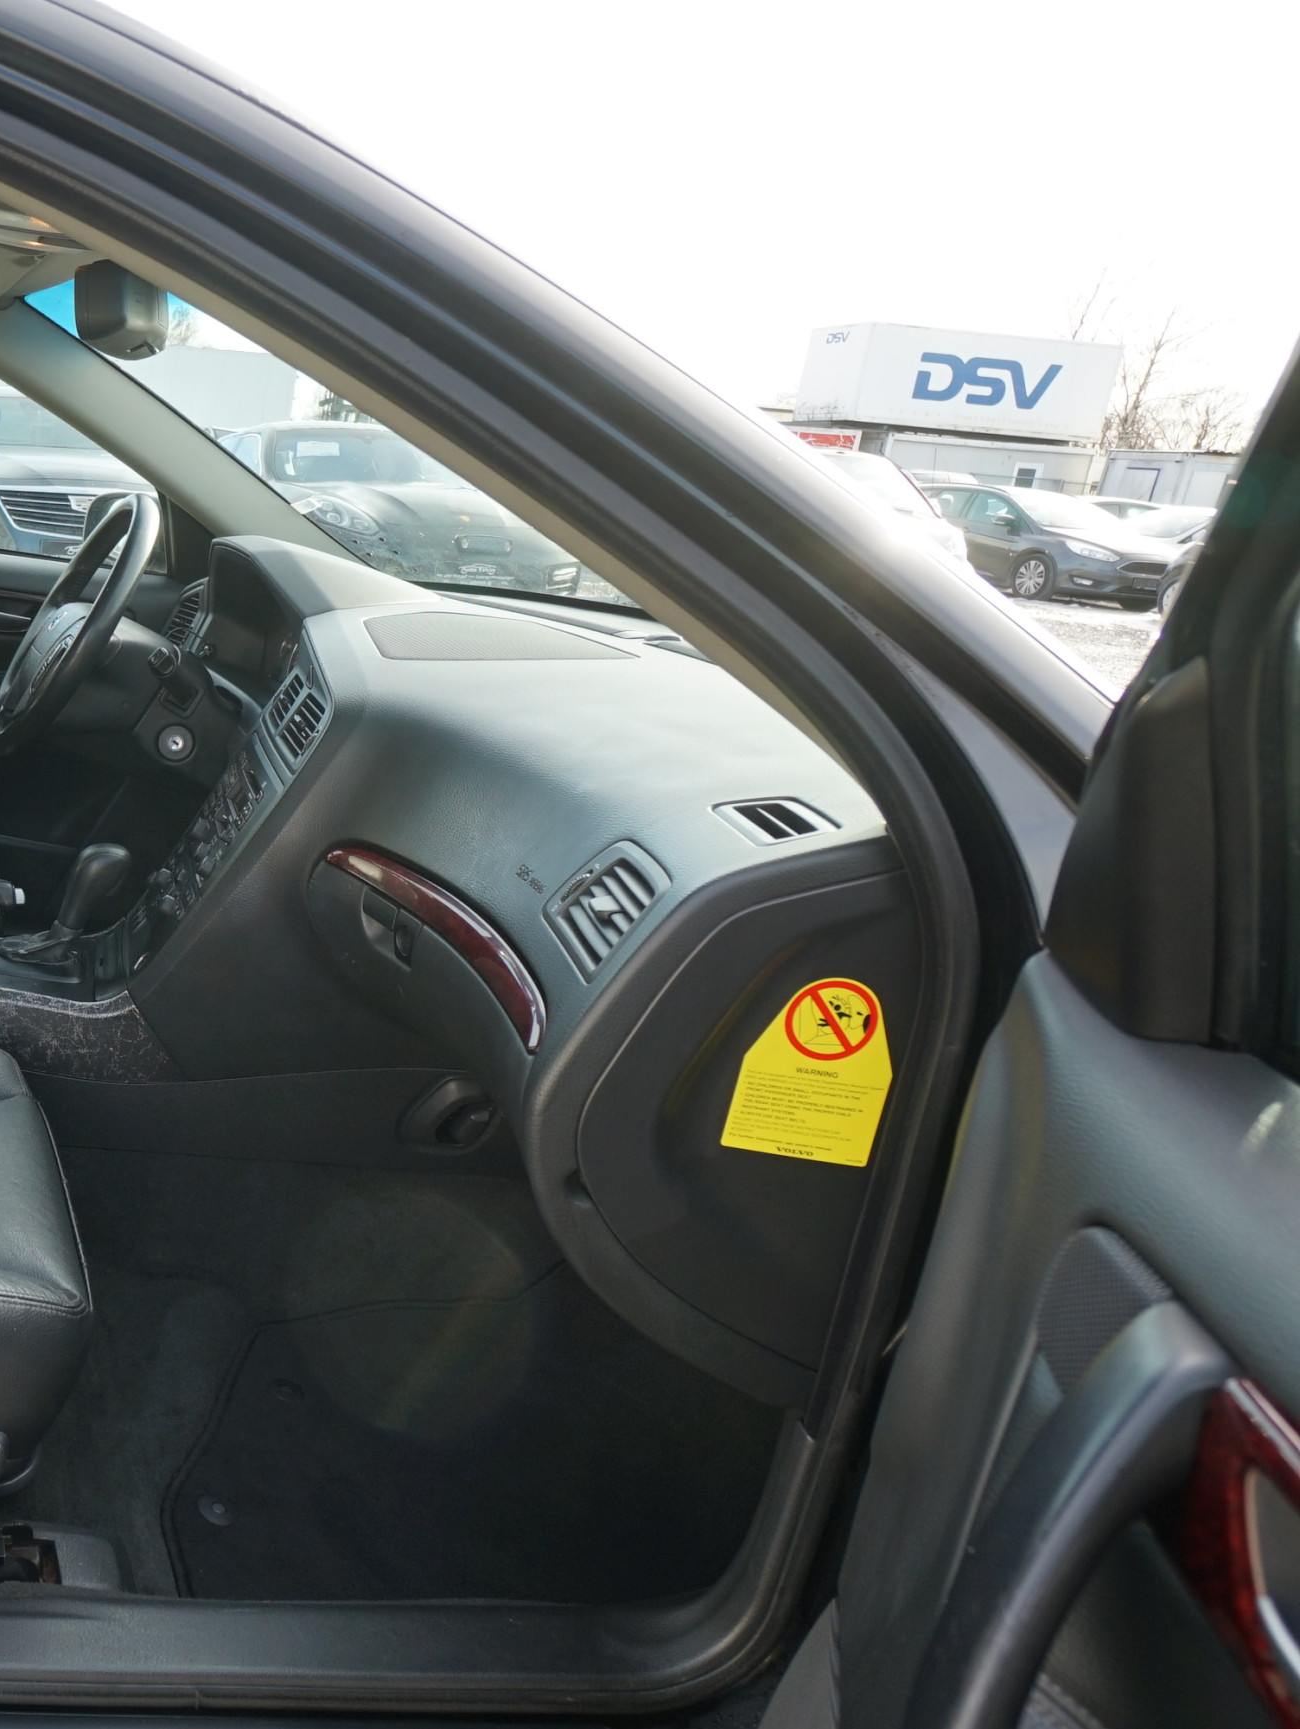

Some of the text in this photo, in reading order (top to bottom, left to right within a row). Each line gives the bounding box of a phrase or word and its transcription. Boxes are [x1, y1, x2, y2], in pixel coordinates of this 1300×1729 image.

[826, 331, 851, 344] DSV
[911, 352, 1063, 410] DSV
[796, 1067, 839, 1078] WARNING
[776, 1147, 814, 1156] VOLVO
